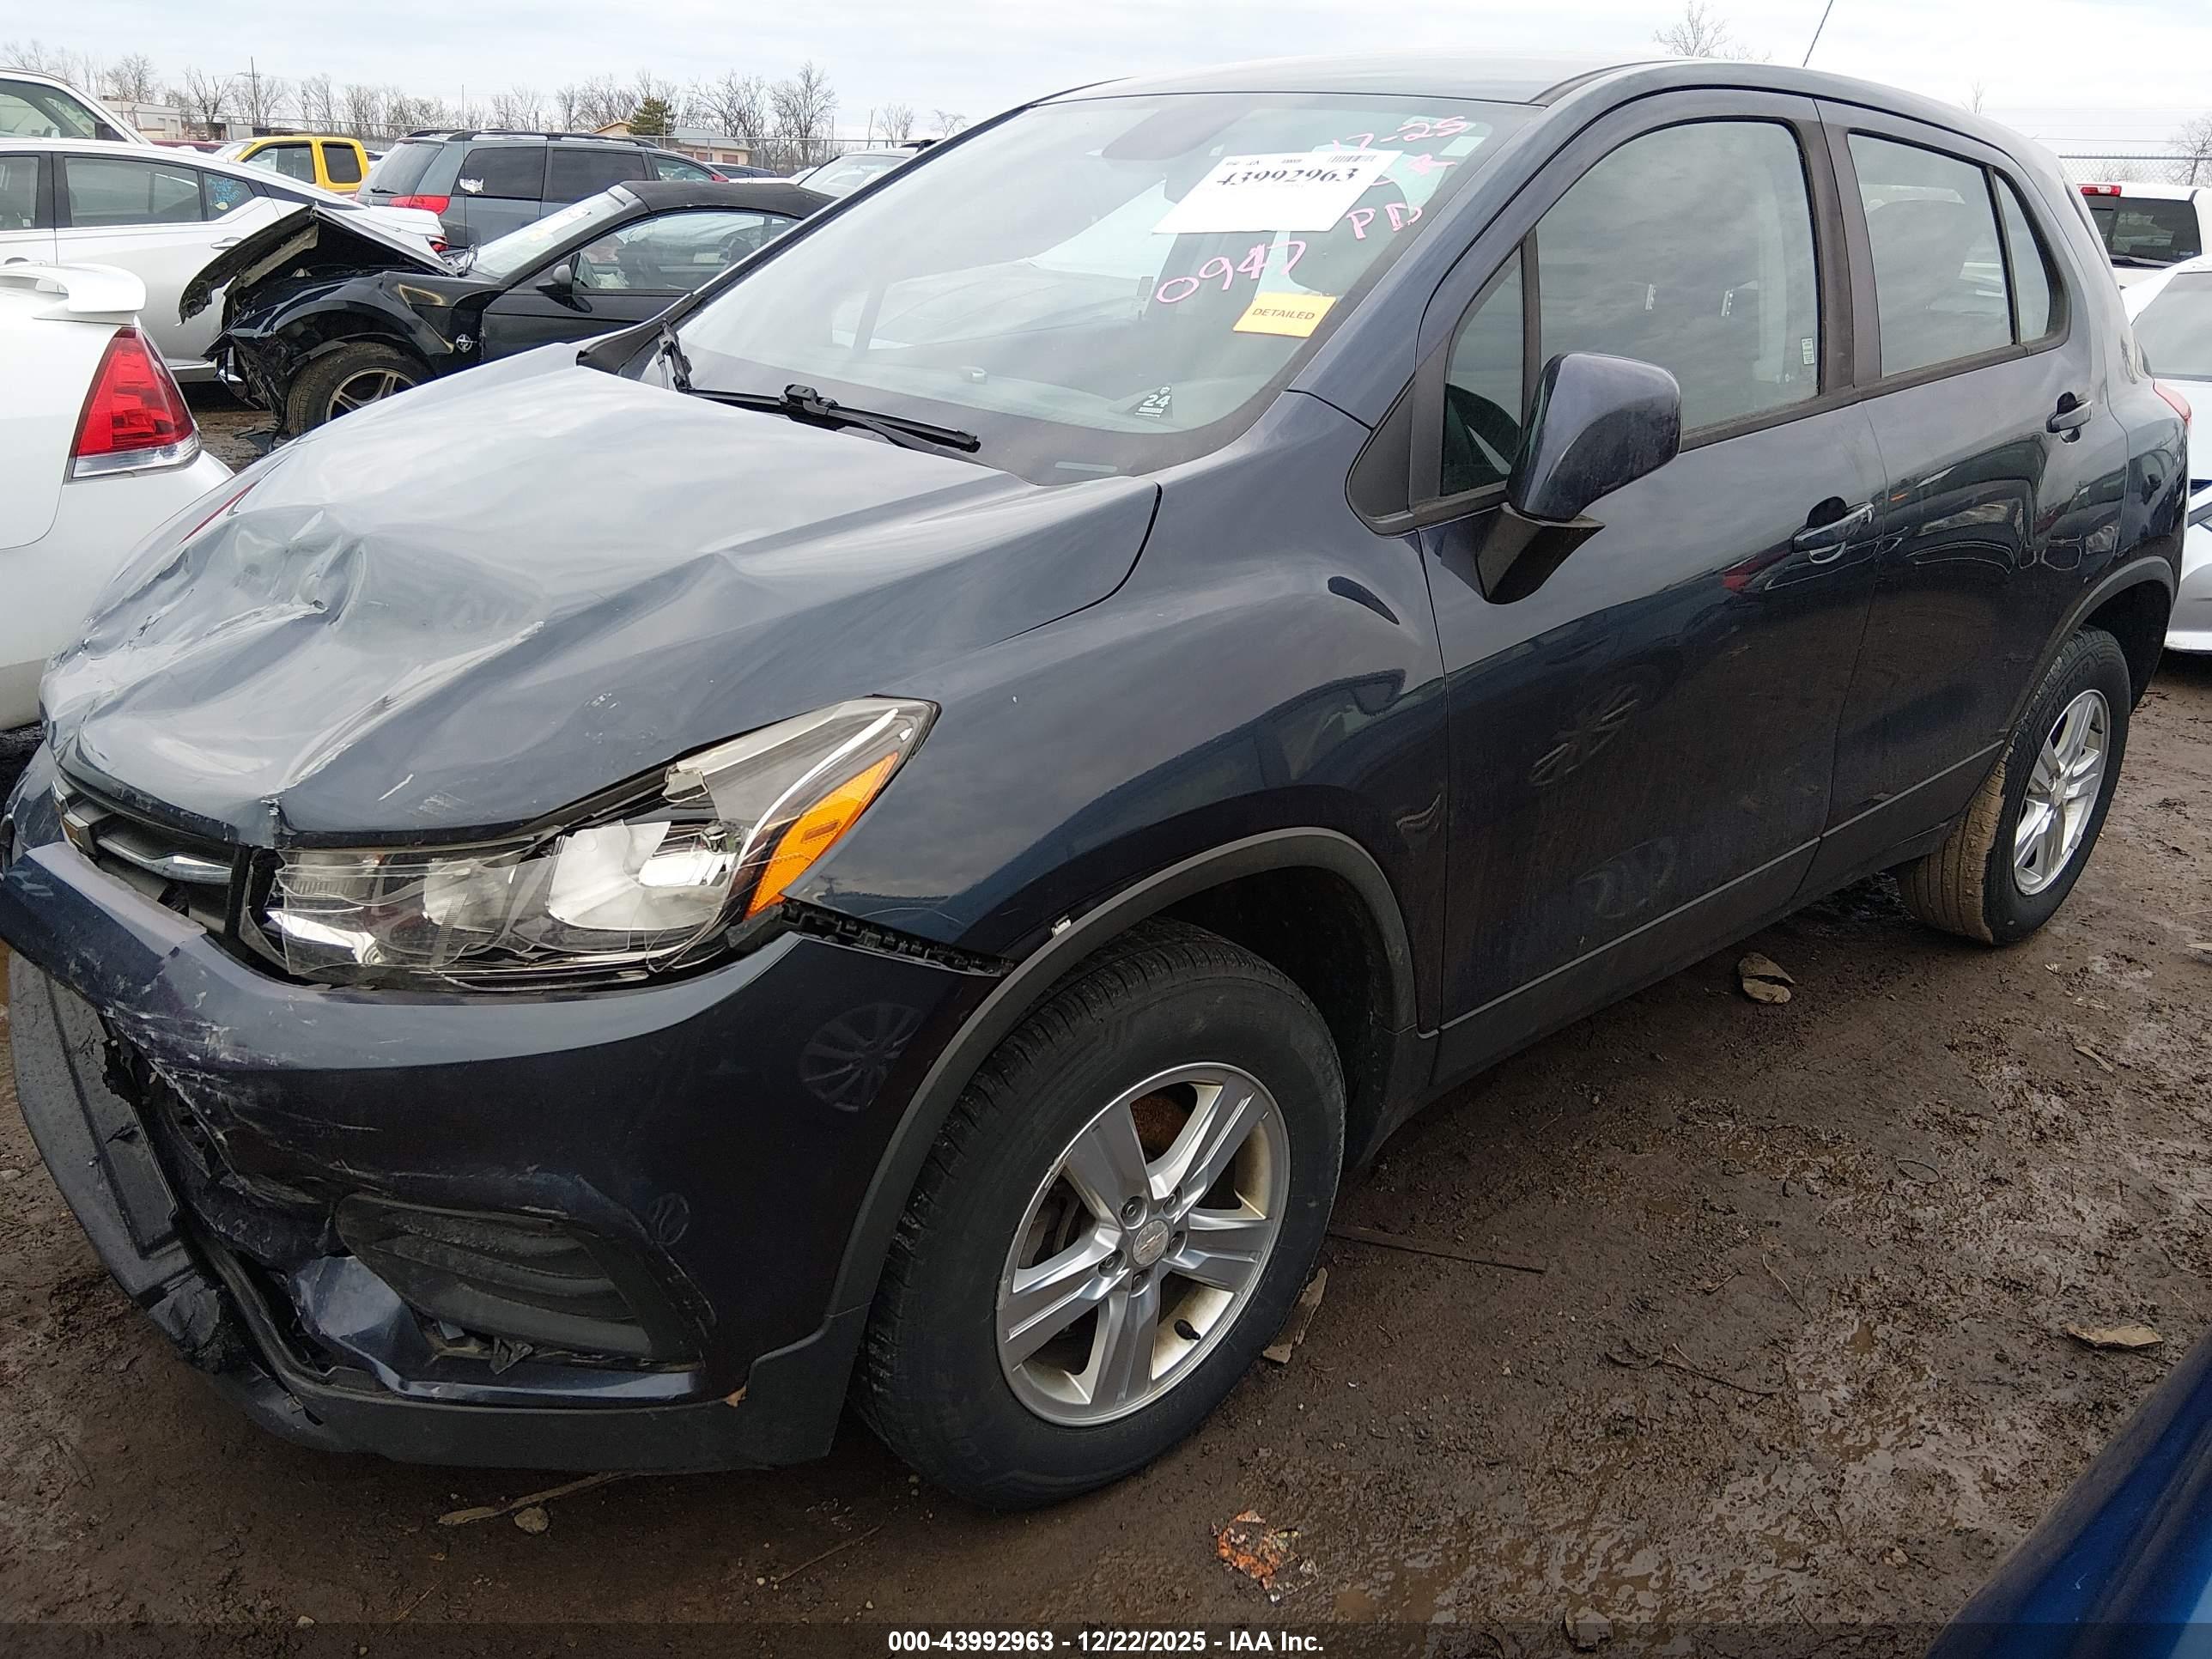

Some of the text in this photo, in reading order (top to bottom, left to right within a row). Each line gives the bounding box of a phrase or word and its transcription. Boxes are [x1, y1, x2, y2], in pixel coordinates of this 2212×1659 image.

[1216, 167, 1359, 185] 43992963
[1156, 240, 1307, 304] 0947
[1252, 307, 1316, 320] DETAILED
[1142, 394, 1171, 408] 24
